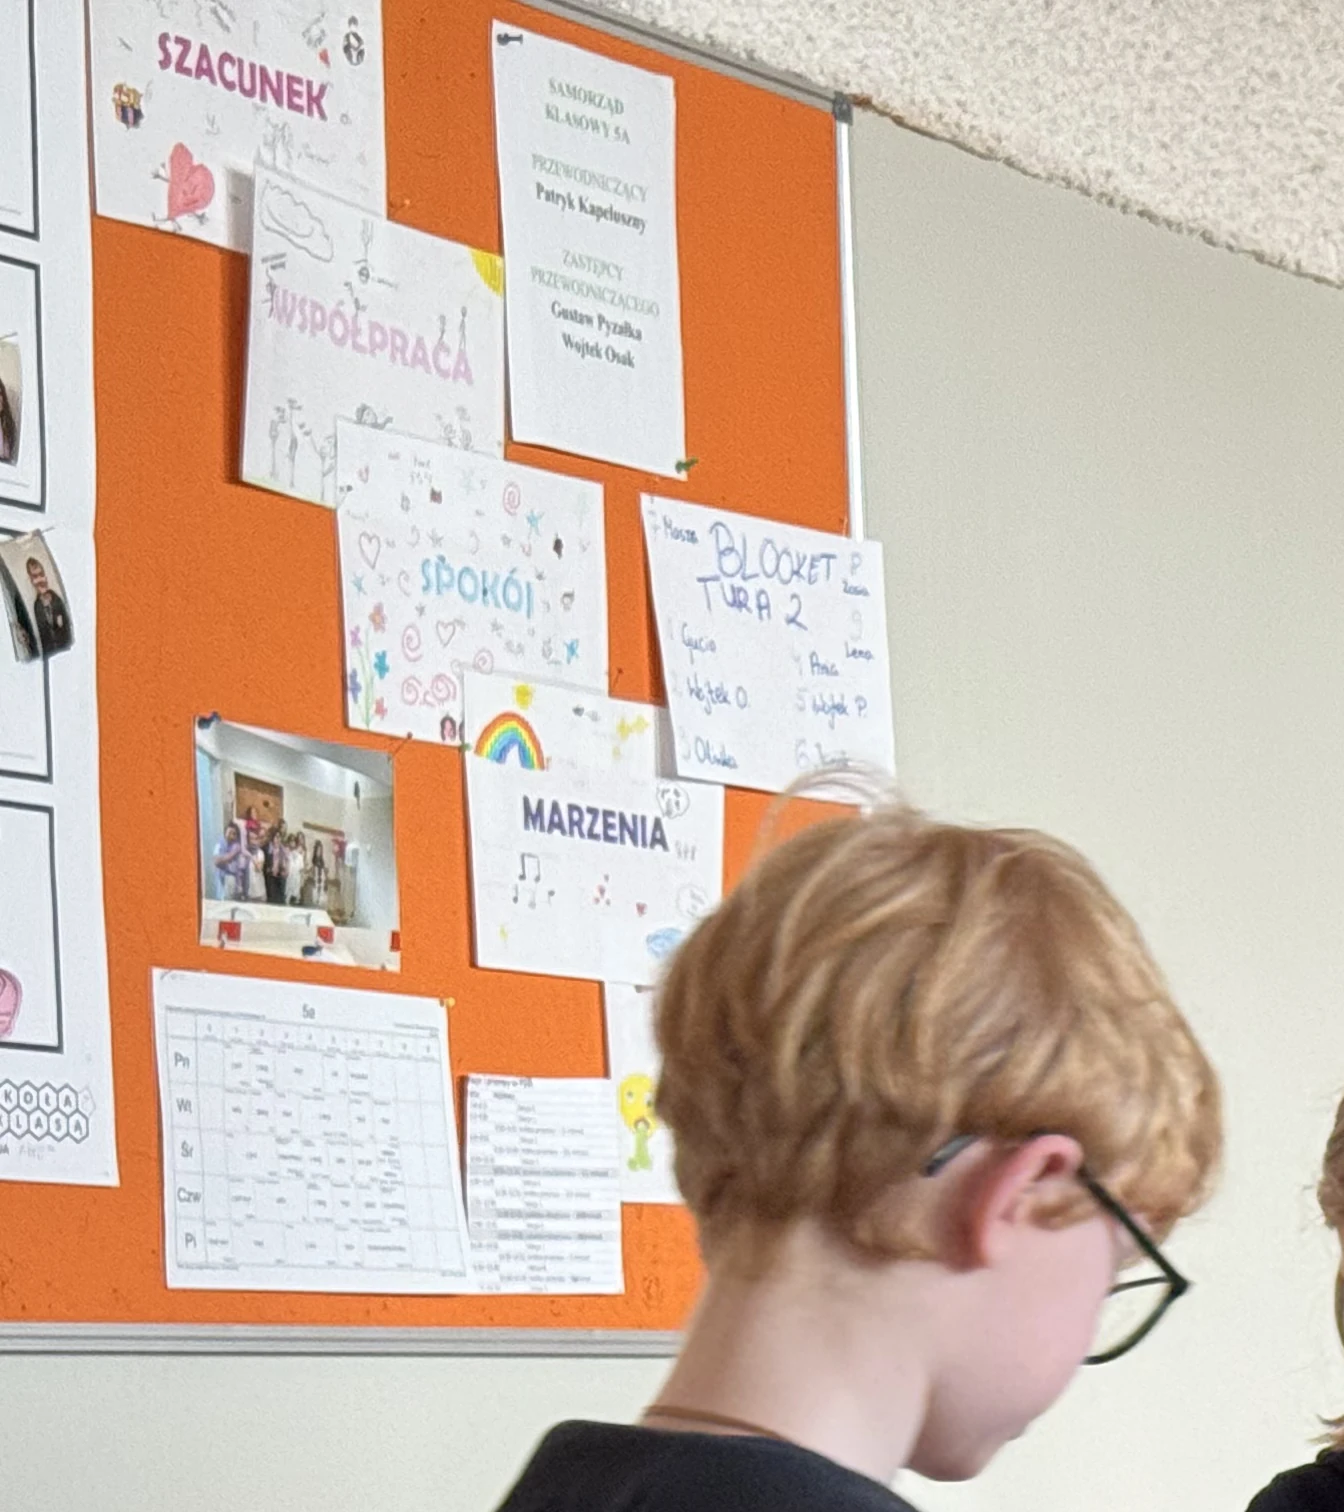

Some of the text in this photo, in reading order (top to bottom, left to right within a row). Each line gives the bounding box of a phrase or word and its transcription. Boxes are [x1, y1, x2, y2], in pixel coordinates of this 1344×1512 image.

[158, 32, 328, 121] SZACUNEK
[549, 78, 624, 116] SAMORZĄD
[545, 102, 631, 145] KLASOWY 5A
[532, 153, 648, 203] PRZEWODNICZĄCY
[536, 182, 646, 235] Patryk Kapeluszny
[273, 288, 473, 386] WSPÓŁPRACA
[551, 300, 594, 328] Gustaw
[562, 332, 635, 369] Wojtek Osak
[709, 521, 837, 586] BLOOKET
[696, 575, 808, 631] TURA 2
[522, 794, 669, 852] MARZENIA
[174, 1051, 190, 1069] Pn
[177, 1186, 201, 1204] Czw
